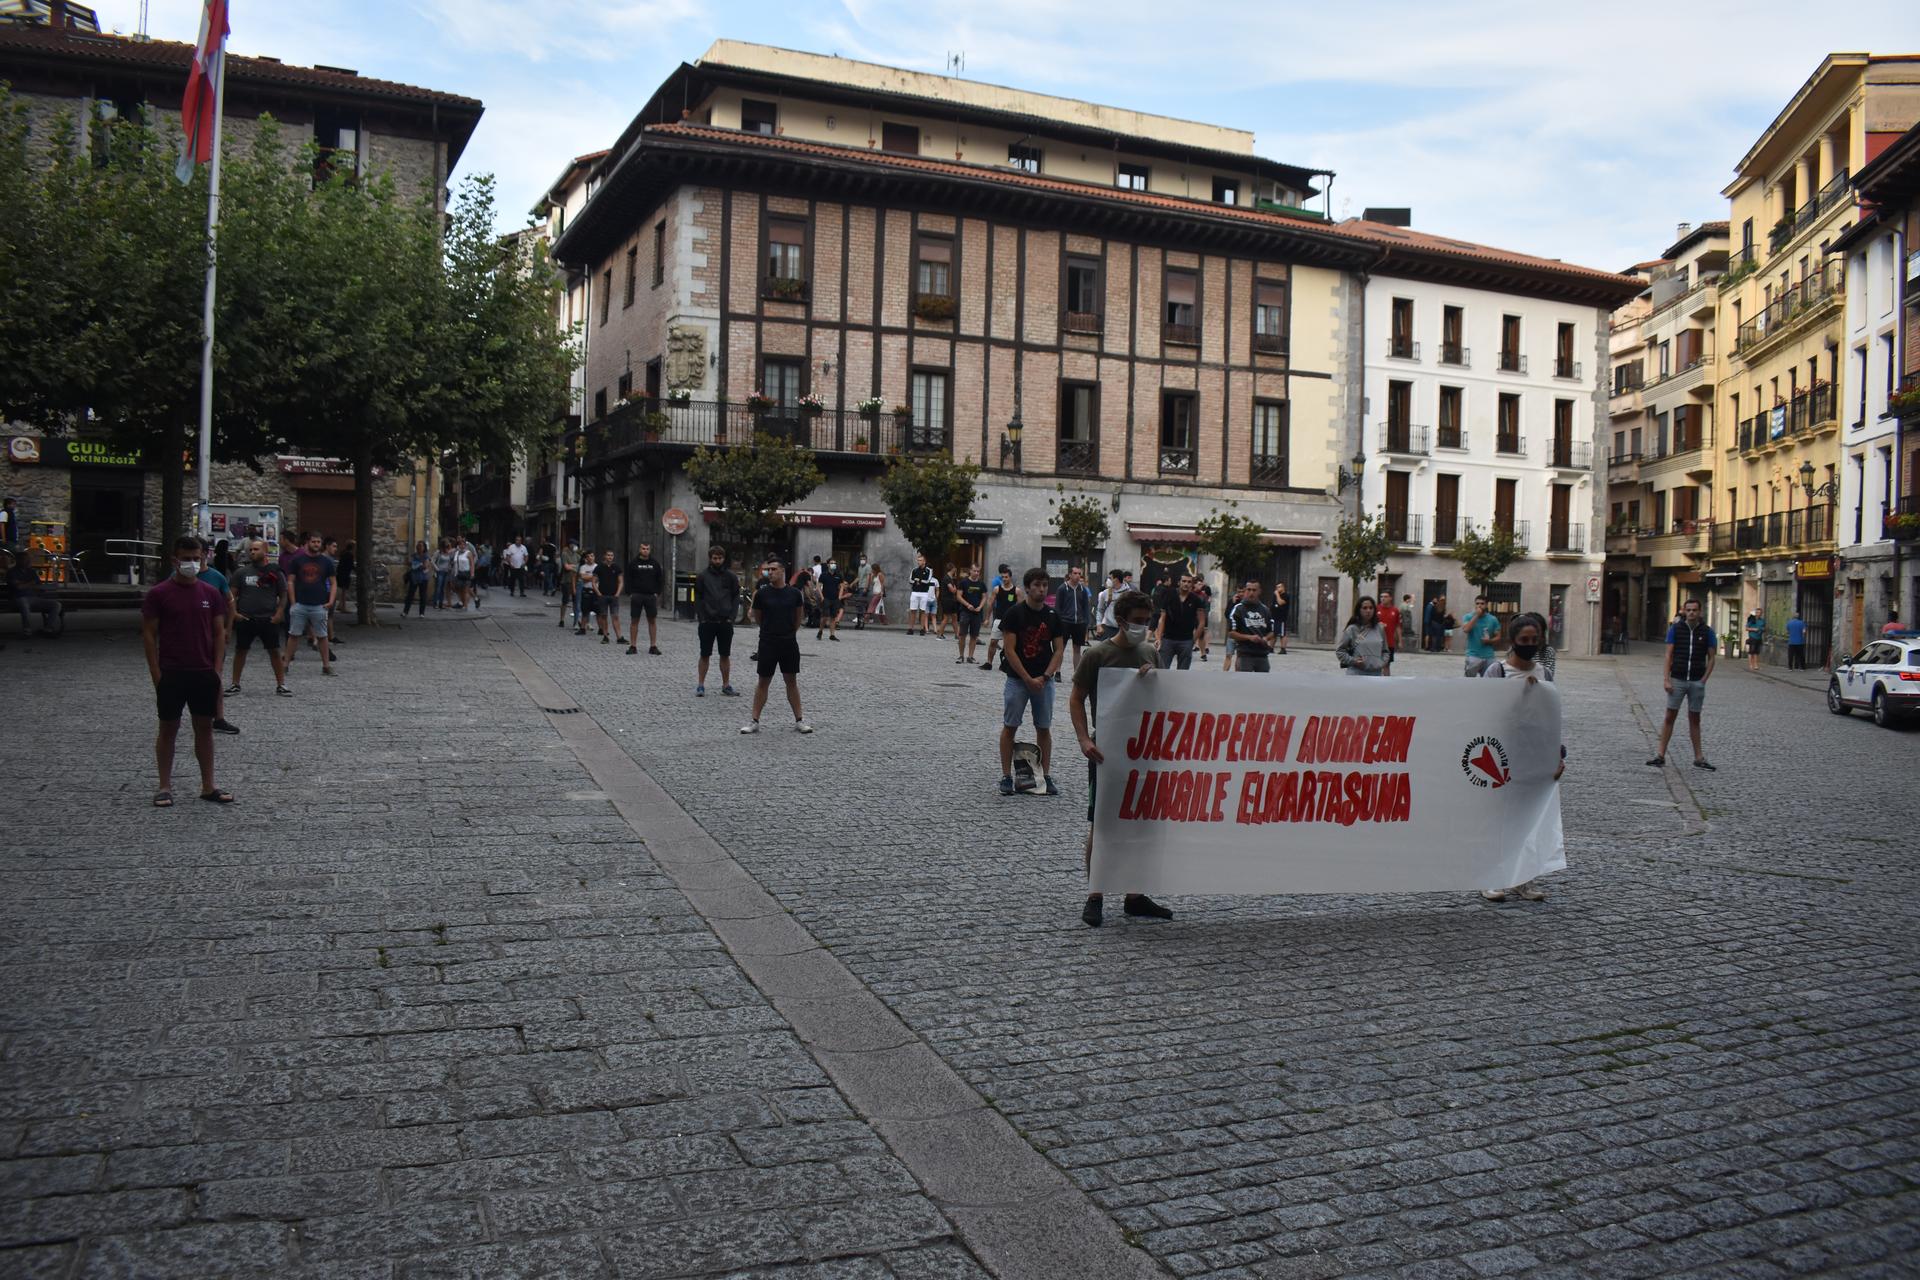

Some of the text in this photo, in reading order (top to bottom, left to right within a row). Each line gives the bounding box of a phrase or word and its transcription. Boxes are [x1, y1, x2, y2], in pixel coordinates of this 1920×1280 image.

[72, 455, 136, 465] OKINDEGIA
[1127, 711, 1416, 764] JAZARPENEN AURREAN
[1119, 769, 1411, 826] LANGILE ELKARTASUNA
